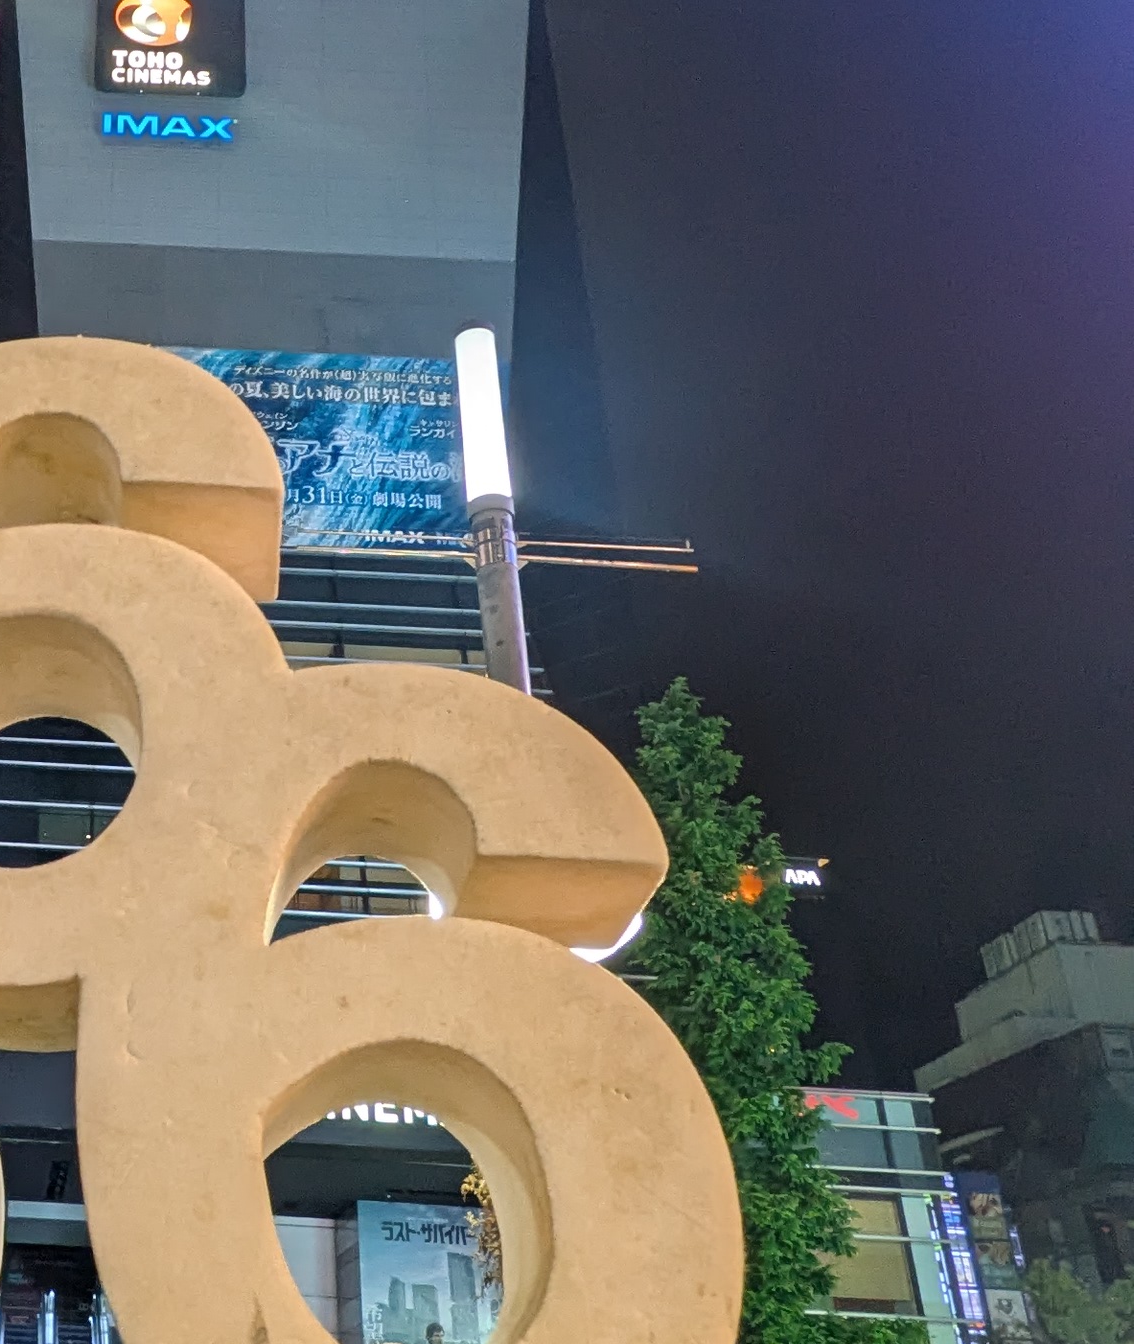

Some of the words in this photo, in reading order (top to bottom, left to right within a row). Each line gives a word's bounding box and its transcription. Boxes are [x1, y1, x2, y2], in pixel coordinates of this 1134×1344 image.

[112, 49, 183, 69] TOHO
[111, 67, 212, 87] CINEMAS
[102, 112, 235, 141] IMAX
[275, 438, 461, 482] アナと伝説の
[784, 867, 822, 887] APA
